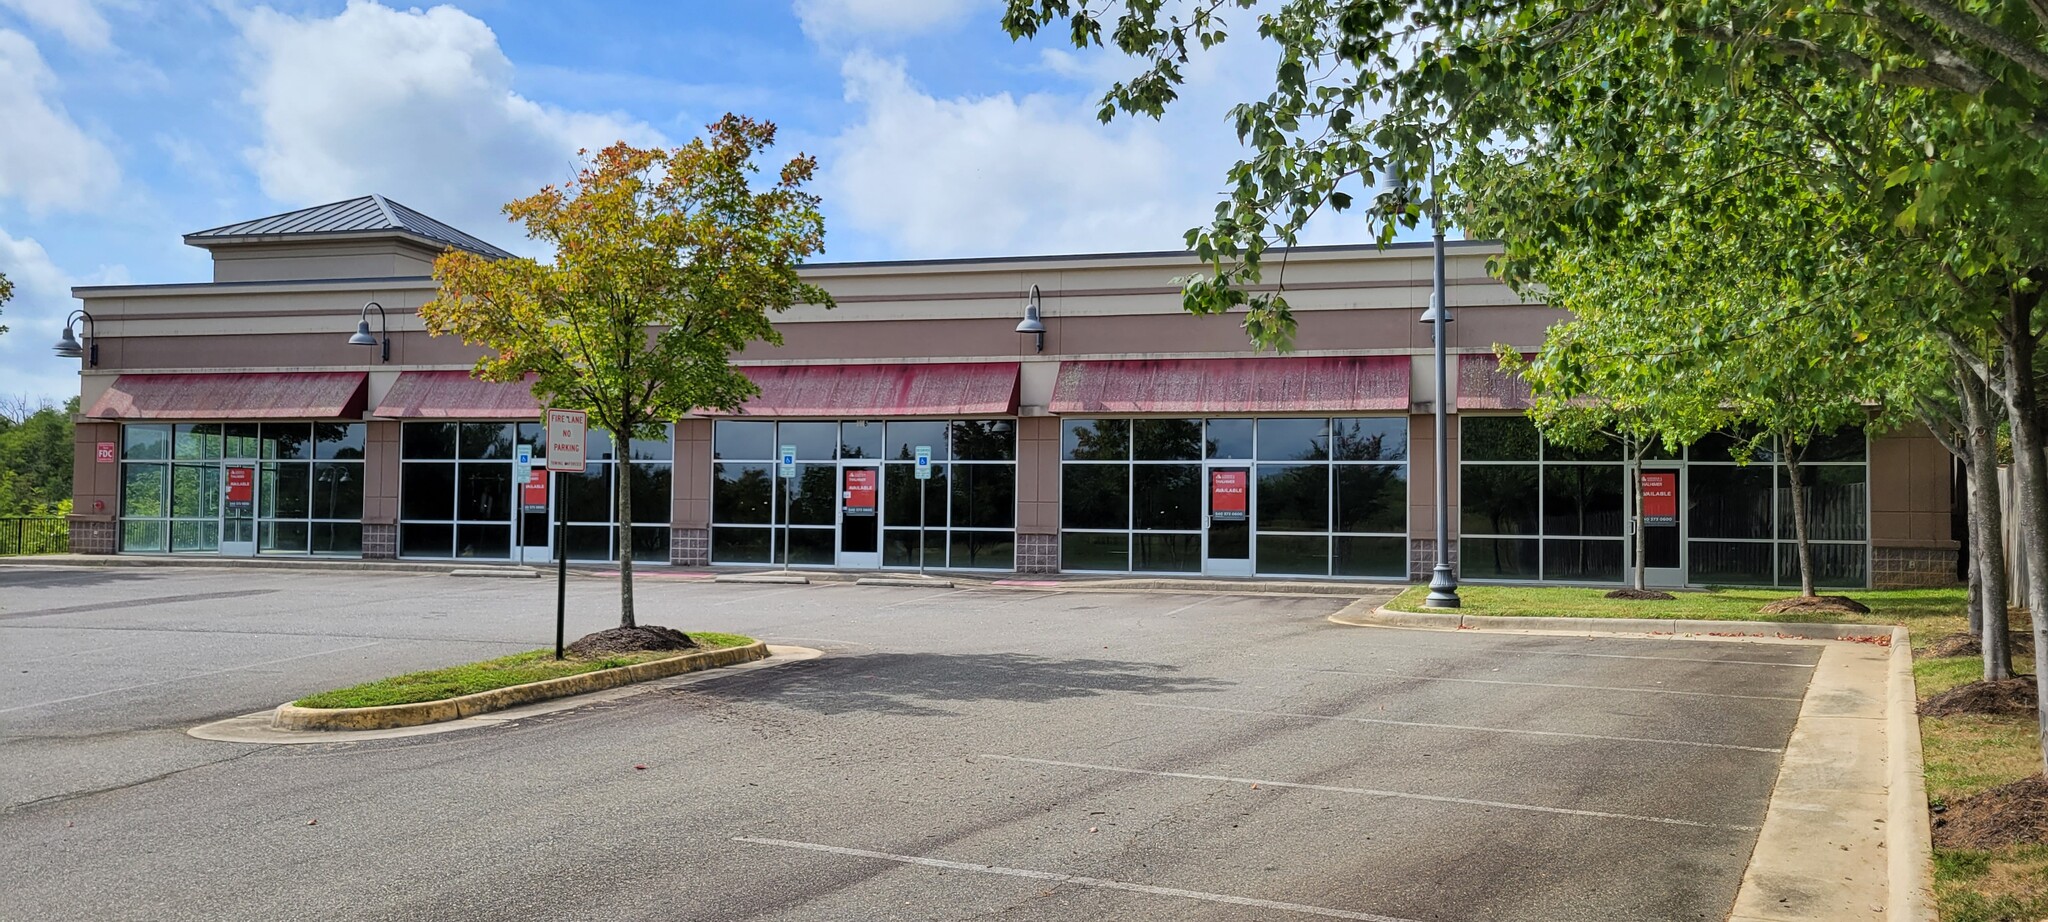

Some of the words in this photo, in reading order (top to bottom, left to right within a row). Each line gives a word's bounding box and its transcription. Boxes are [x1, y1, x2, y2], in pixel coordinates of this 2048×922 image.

[551, 414, 565, 423] FIRE
[567, 416, 583, 424] LANE
[553, 443, 580, 452] PARKING
[98, 450, 112, 458] FDC
